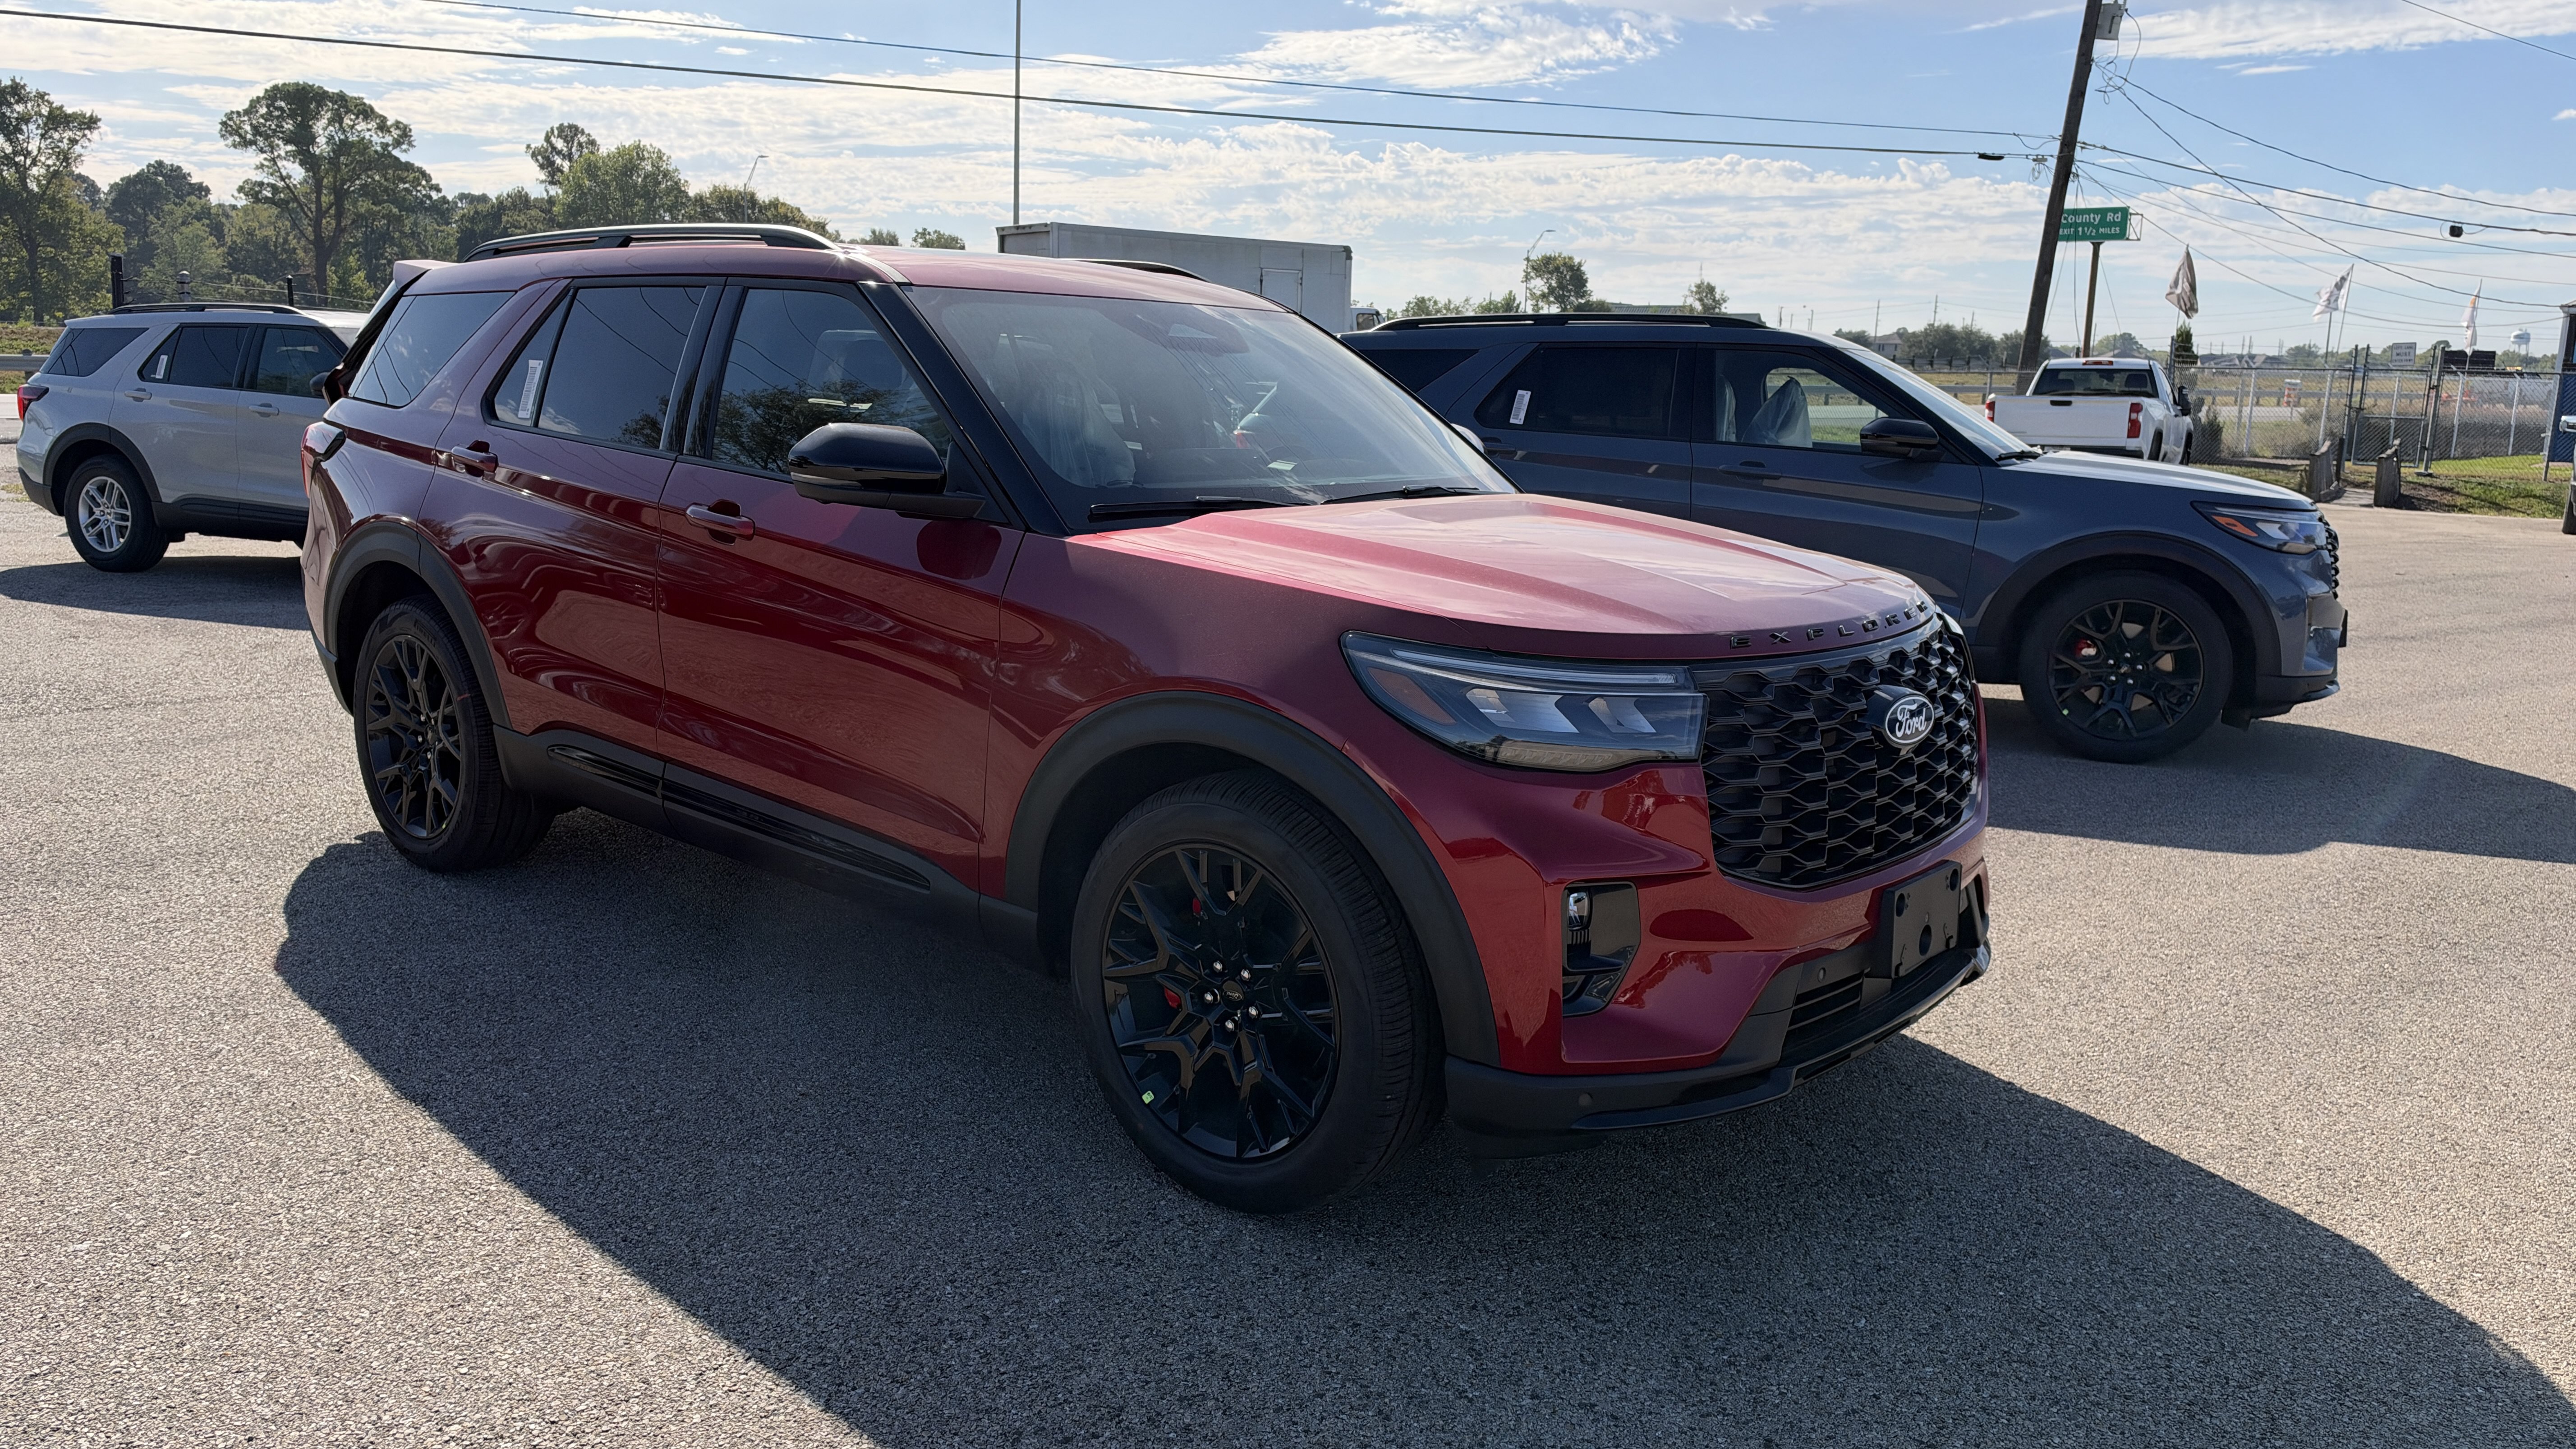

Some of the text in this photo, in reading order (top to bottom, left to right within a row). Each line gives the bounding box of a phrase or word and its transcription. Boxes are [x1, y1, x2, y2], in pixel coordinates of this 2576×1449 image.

[2061, 212, 2121, 224] County Rd
[1730, 600, 1928, 649] EXPLORER
[1895, 702, 1926, 738] Ford
